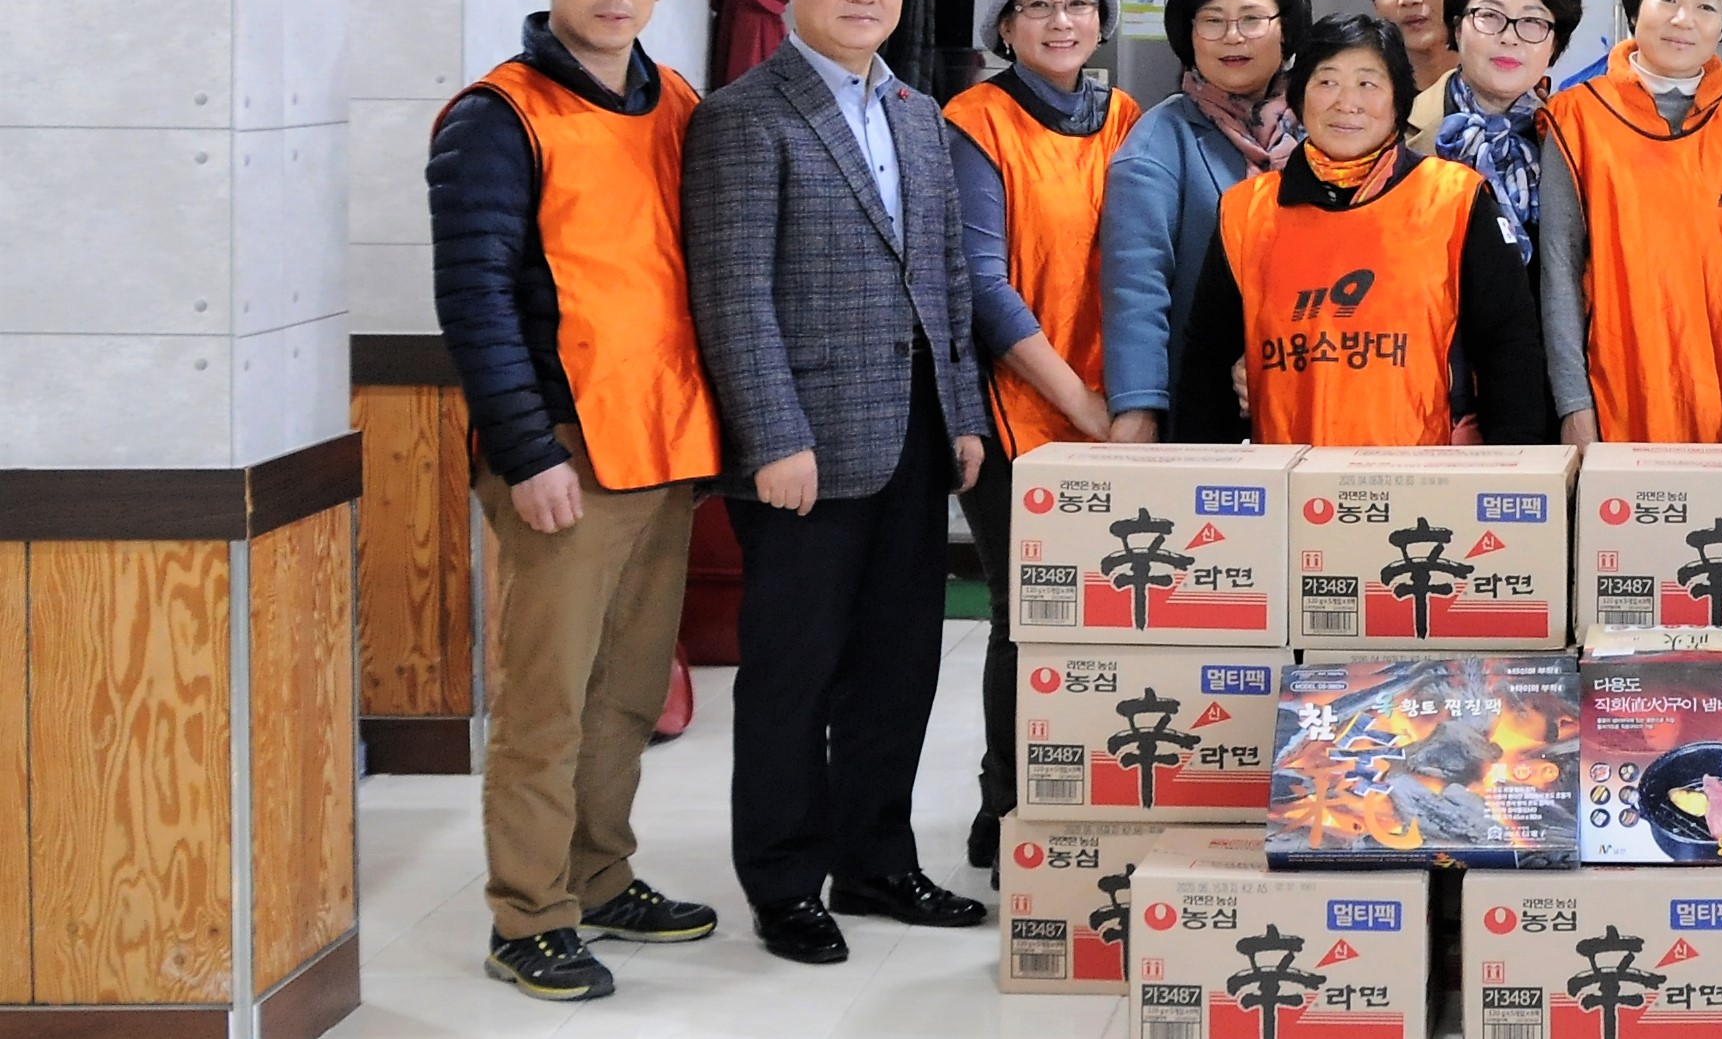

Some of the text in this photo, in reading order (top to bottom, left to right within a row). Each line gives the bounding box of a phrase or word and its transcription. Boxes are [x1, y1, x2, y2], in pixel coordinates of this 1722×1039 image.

[1291, 268, 1376, 322] 119
[1261, 331, 1408, 373] 의용소방대
[1058, 491, 1112, 513] 농심
[1200, 489, 1260, 513] 멀티팩
[1482, 496, 1542, 520] 멀티팩
[1337, 502, 1390, 524] 농심
[1634, 502, 1688, 525] 농심
[1022, 567, 1076, 585] 가3487
[1100, 507, 1195, 631] 辛
[1194, 565, 1255, 591] 라면
[1380, 516, 1475, 640] 辛
[1304, 578, 1357, 595] 가3487
[1473, 572, 1535, 599] 라면
[1599, 577, 1653, 595] 가3487
[1064, 671, 1118, 693] 농심
[1207, 669, 1266, 692] 멀티팩
[1594, 677, 1642, 693] 다용도
[1400, 699, 1439, 718] 황토
[1444, 698, 1502, 719] 찜질팩
[1298, 703, 1339, 741] 참
[1030, 746, 1083, 763] 가3487
[1107, 687, 1202, 809] 辛
[1200, 744, 1261, 770] 라면
[1047, 848, 1100, 869] 농심
[1181, 907, 1238, 930] 농심
[1333, 903, 1396, 929] 멀티팩
[1520, 910, 1577, 933] 농심
[1013, 921, 1066, 938] 가3487
[1226, 923, 1327, 1039] 辛
[1566, 924, 1667, 1039] 辛
[1144, 987, 1200, 1005] 가3487
[1325, 984, 1390, 1011] 라면
[1485, 989, 1542, 1007] 가3487
